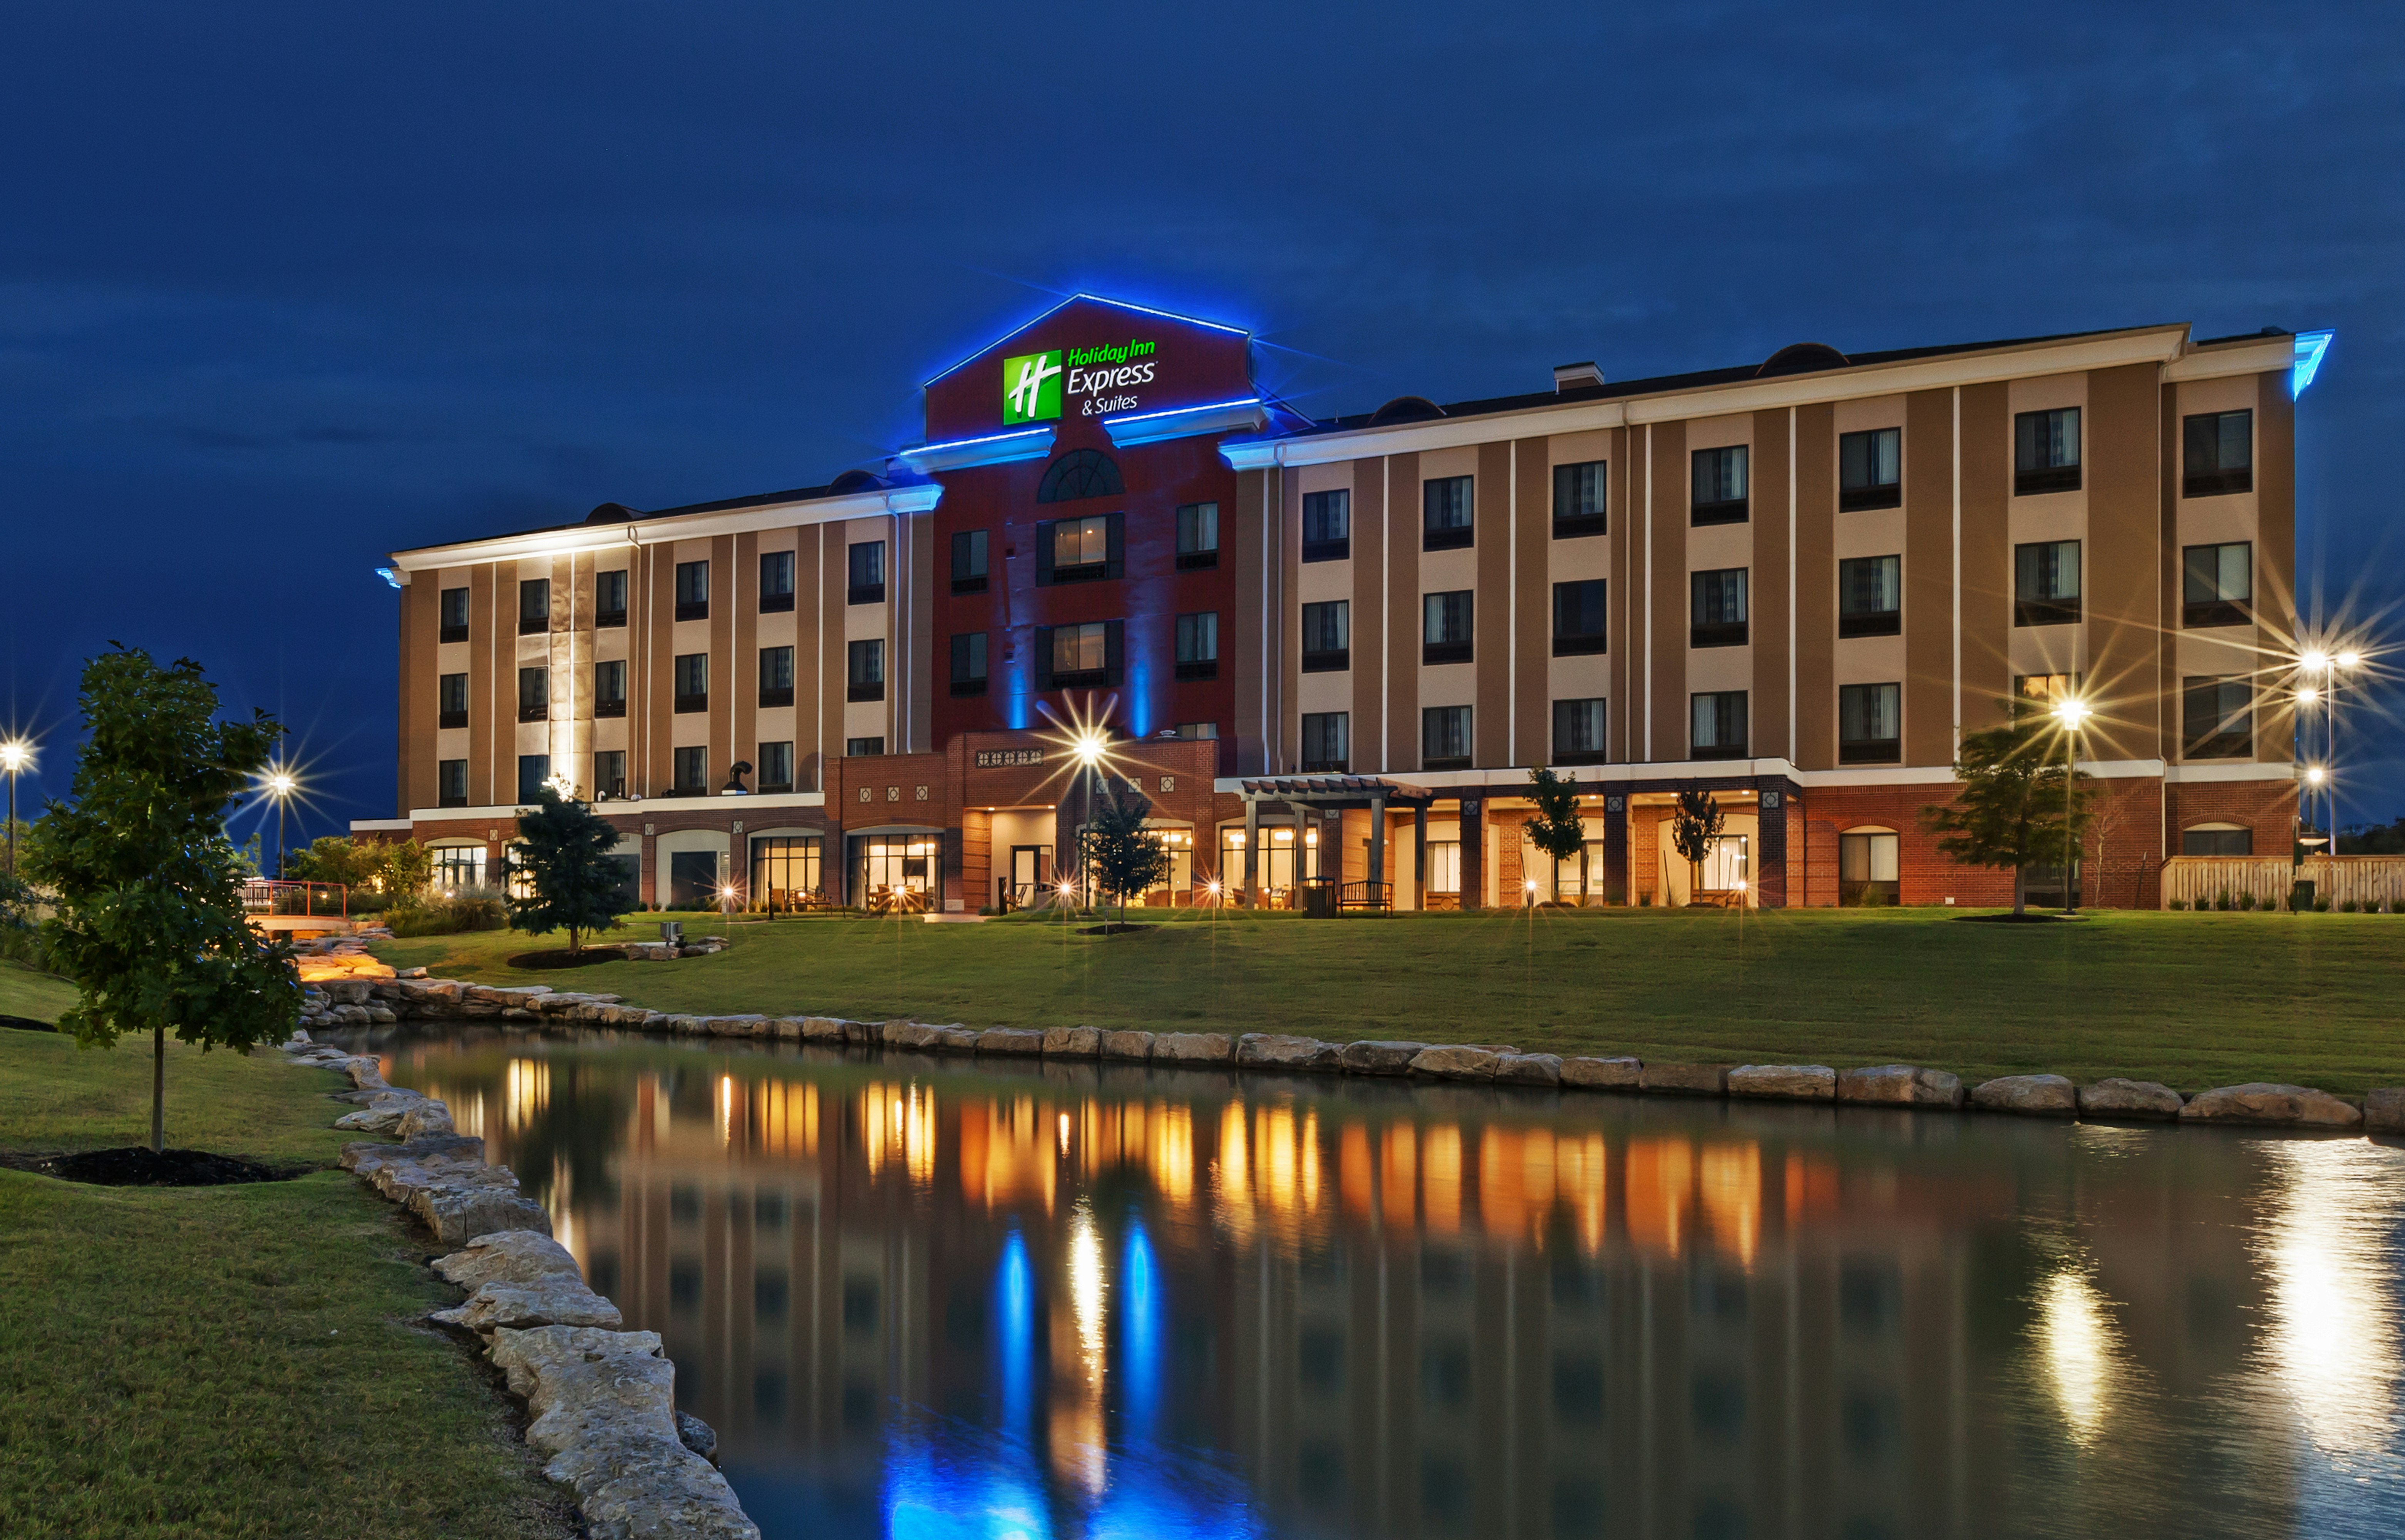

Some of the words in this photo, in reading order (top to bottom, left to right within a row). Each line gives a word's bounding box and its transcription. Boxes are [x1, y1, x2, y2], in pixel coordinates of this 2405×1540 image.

[1068, 343, 1128, 367] Holiday
[1129, 339, 1155, 357] Inn
[1067, 362, 1155, 397] Express
[1082, 400, 1092, 416] &
[1095, 396, 1137, 415] Suites
